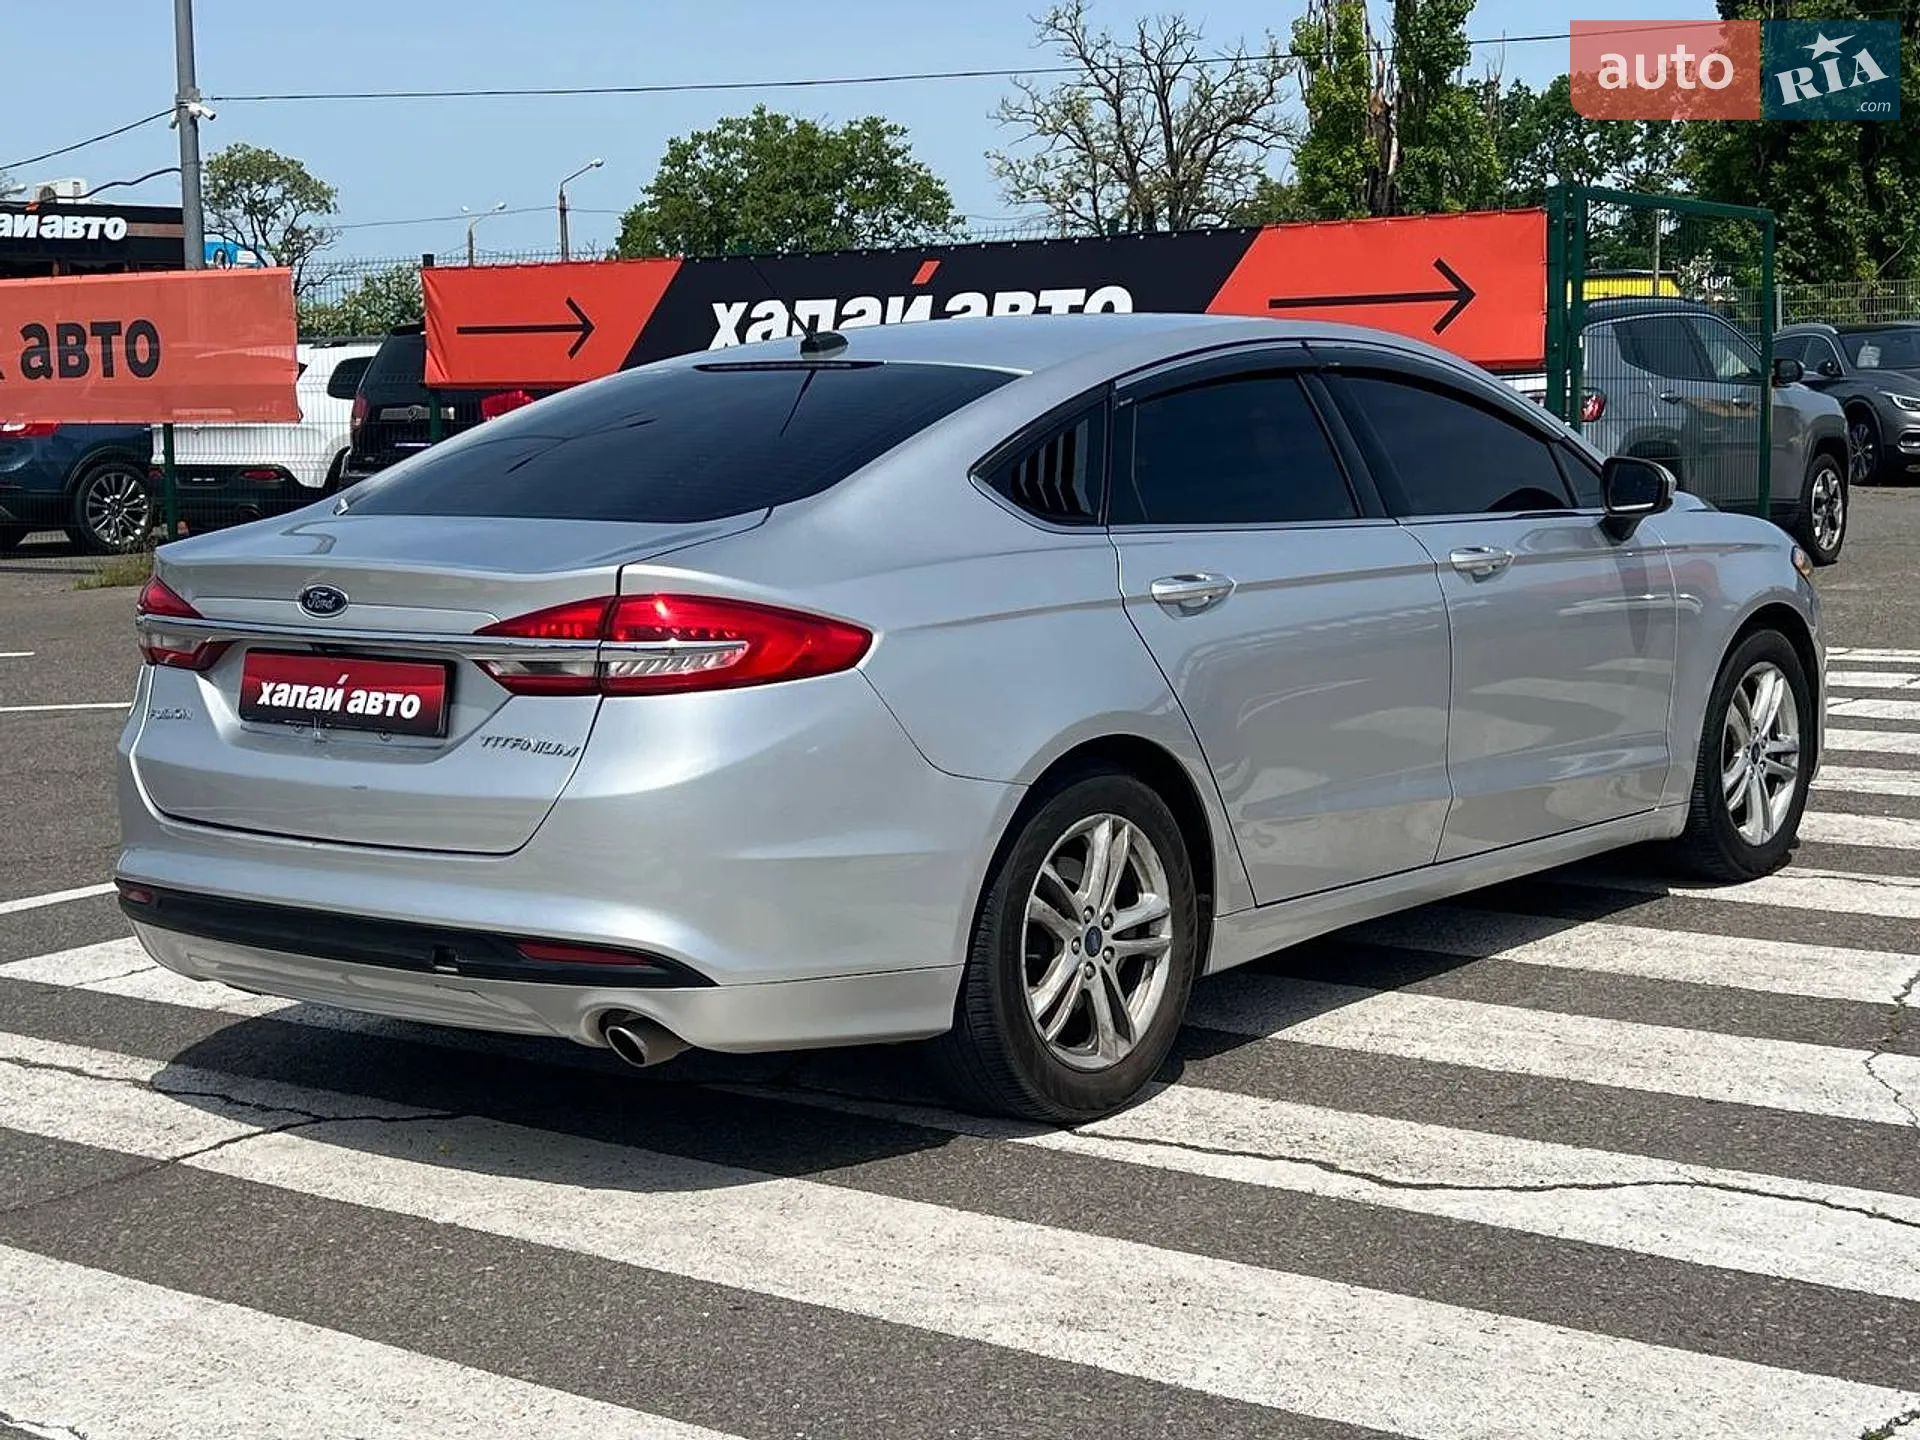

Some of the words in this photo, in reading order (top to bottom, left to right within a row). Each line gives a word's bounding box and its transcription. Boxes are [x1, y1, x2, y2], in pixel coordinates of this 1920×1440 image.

[39, 214, 128, 241] авто
[20, 319, 160, 380] авто
[257, 674, 349, 712] хапай
[346, 689, 421, 719] авто
[480, 736, 580, 758] TITANIUM
